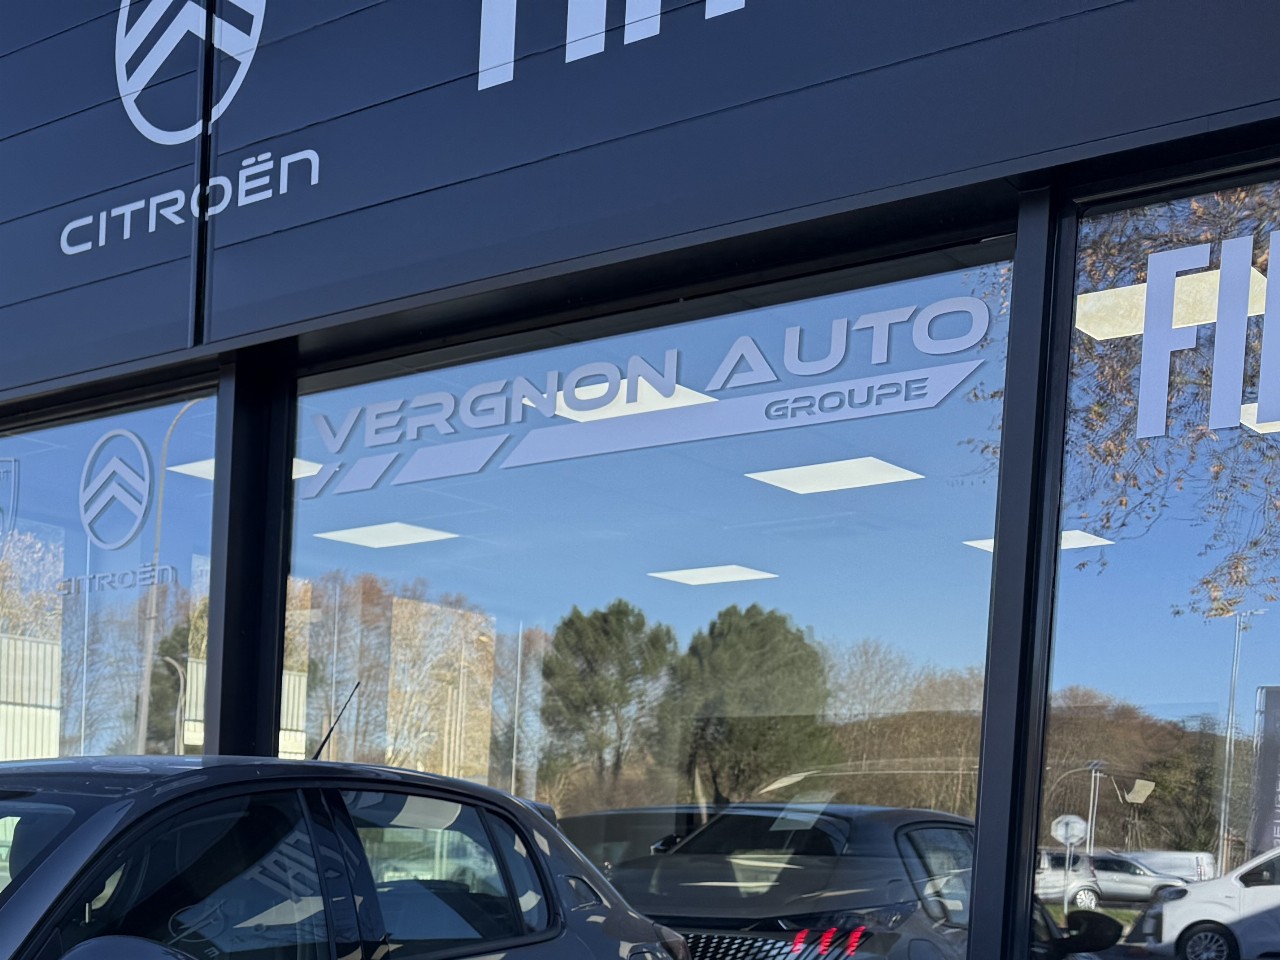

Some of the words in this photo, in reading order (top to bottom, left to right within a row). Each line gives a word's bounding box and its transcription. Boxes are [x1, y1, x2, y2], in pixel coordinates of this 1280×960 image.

[313, 348, 679, 454] VERGNON
[704, 296, 991, 392] AUTO
[764, 376, 929, 421] GROUPE
